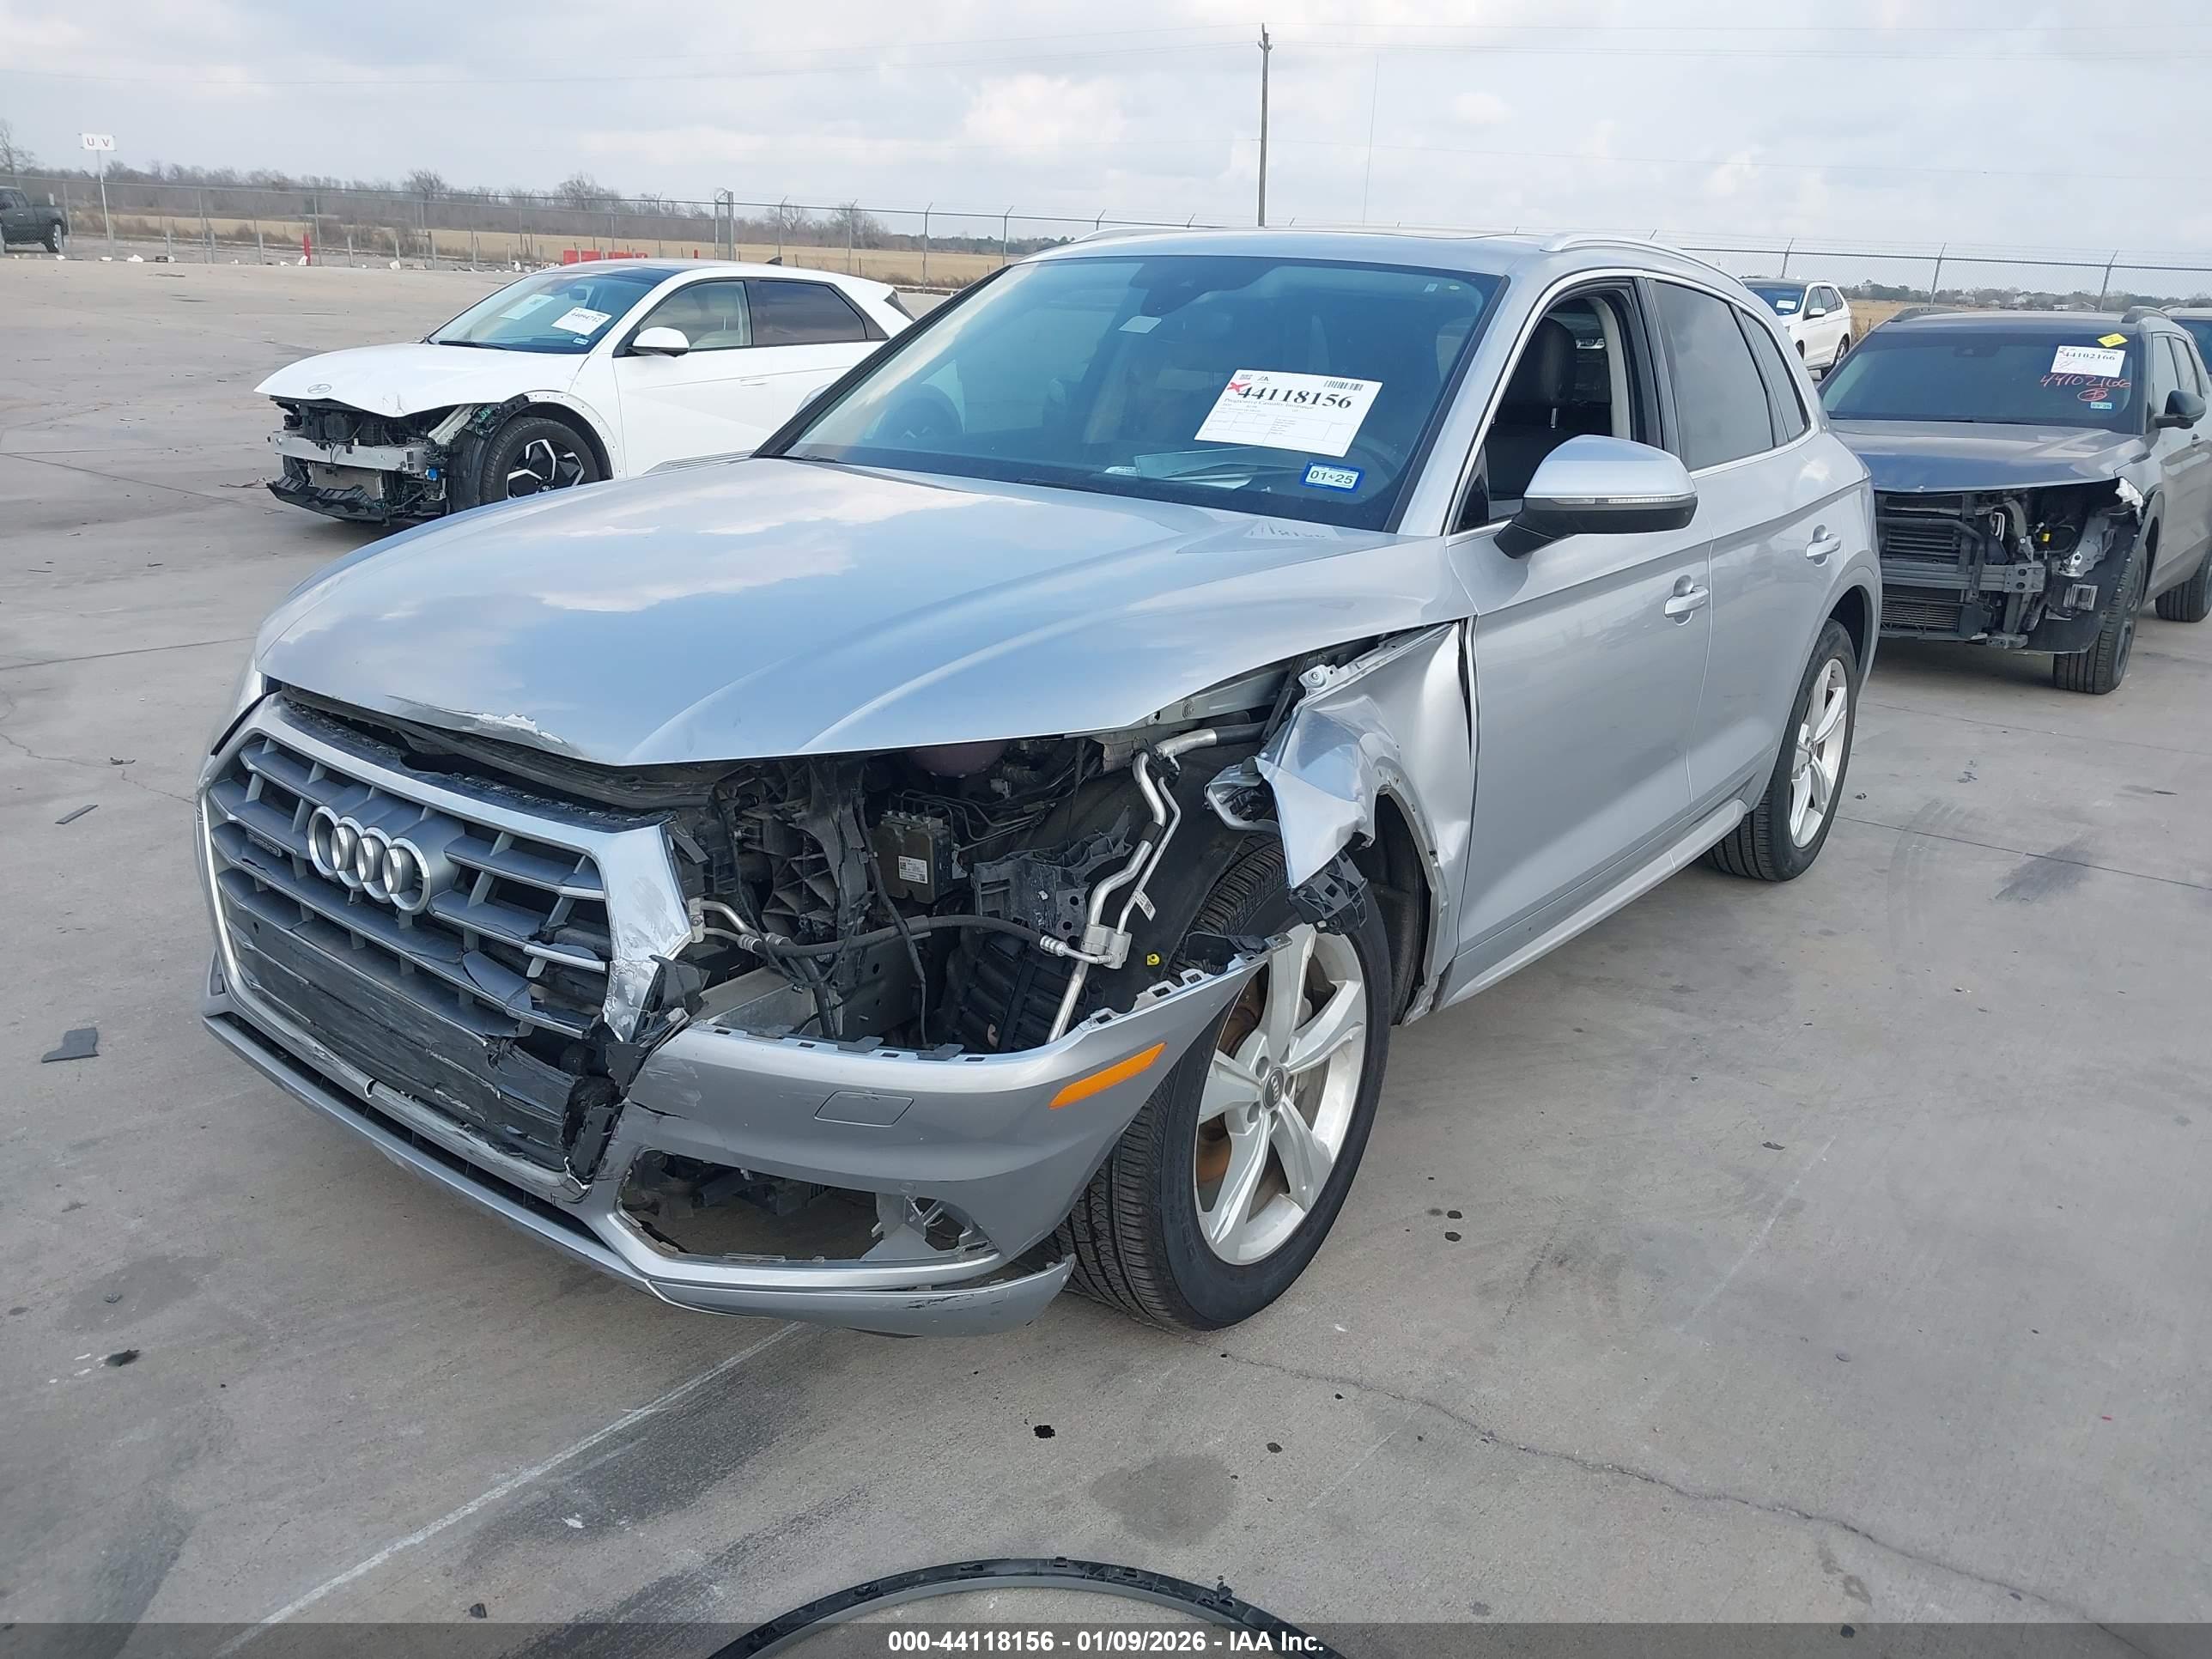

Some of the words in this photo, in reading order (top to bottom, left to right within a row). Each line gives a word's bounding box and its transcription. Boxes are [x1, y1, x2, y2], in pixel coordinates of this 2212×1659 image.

[86, 137, 94, 146] U
[101, 138, 109, 147] V
[2063, 351, 2116, 362] 44102166
[1237, 386, 1354, 409] 44118156
